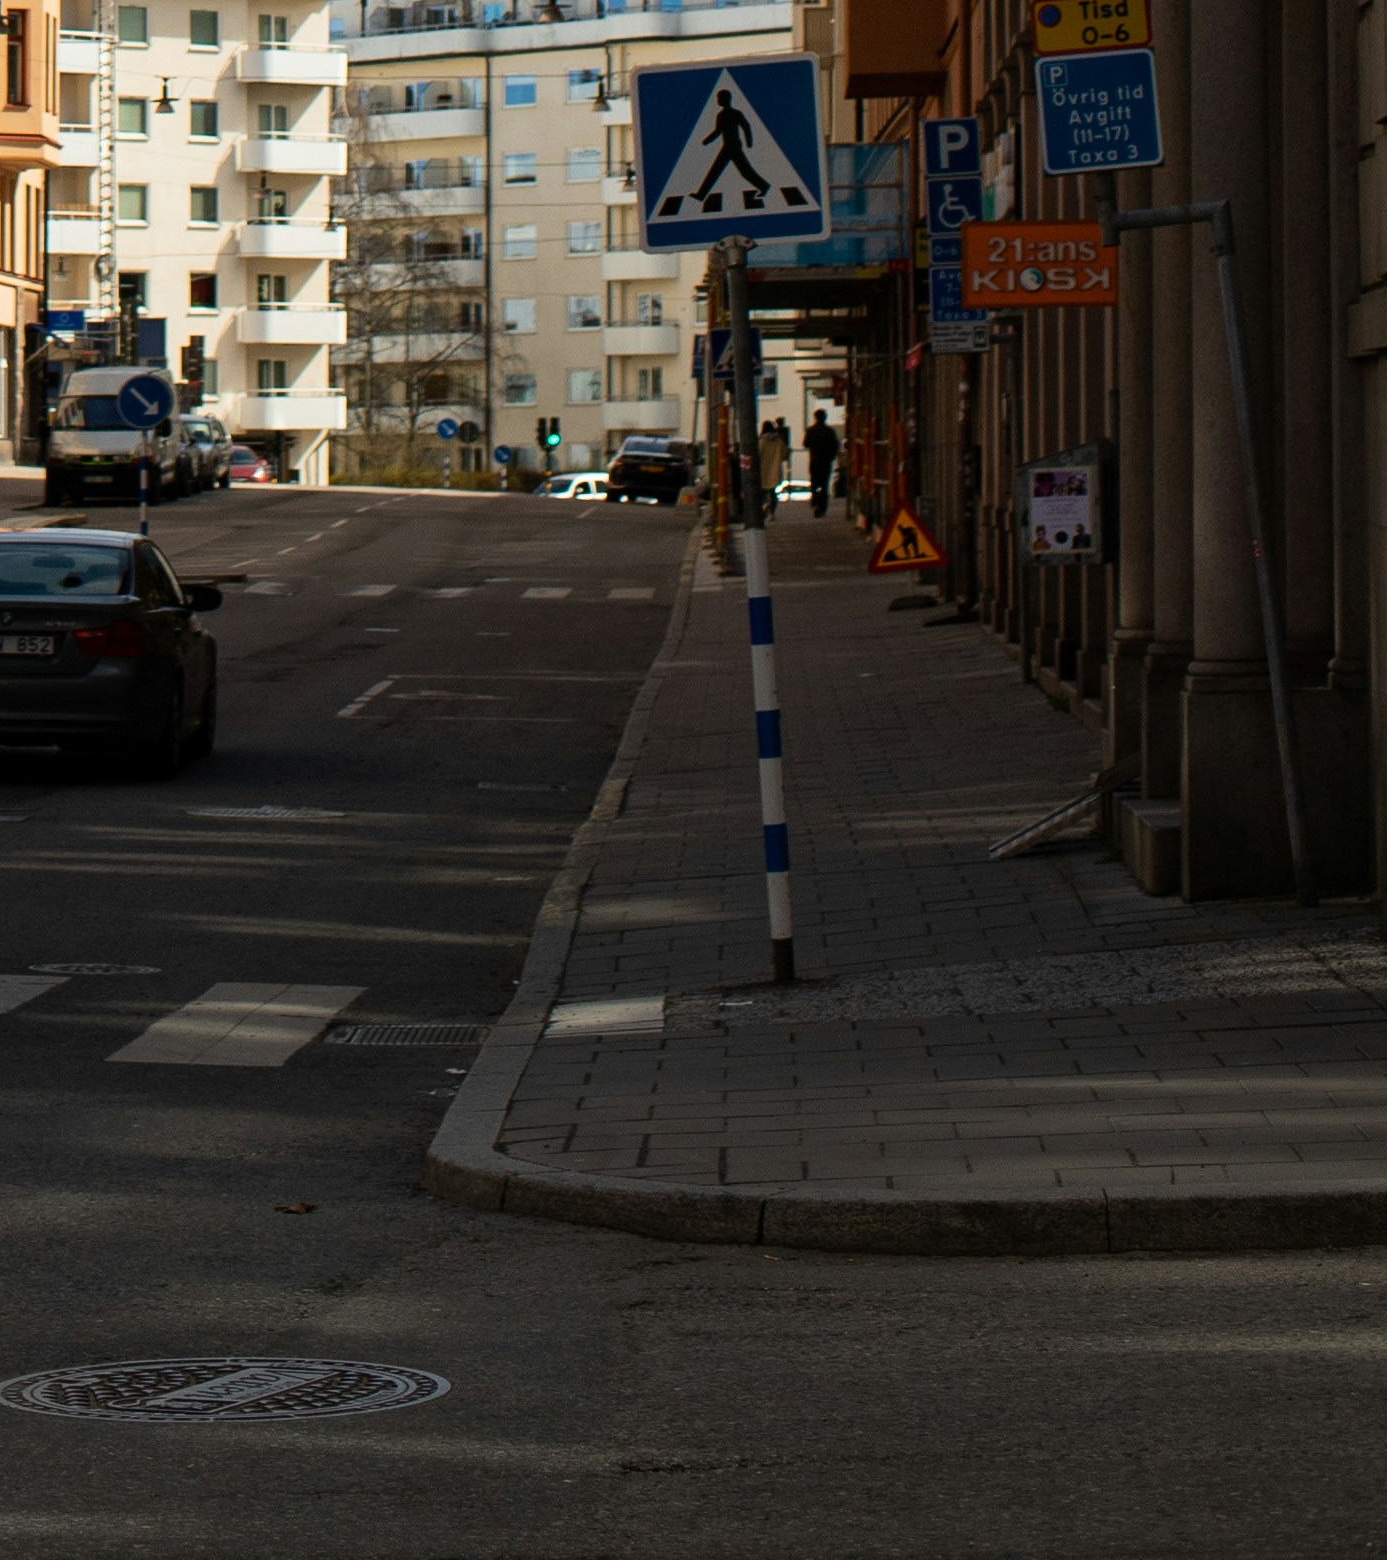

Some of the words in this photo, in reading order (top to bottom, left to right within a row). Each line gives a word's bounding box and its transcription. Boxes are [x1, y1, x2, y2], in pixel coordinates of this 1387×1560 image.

[1082, 23, 1130, 45] 0-6
[1052, 87, 1110, 107] Övrig
[1116, 83, 1144, 101] tid
[1068, 105, 1133, 127] Avgift
[1072, 123, 1131, 146] (11-17)
[937, 123, 971, 170] P
[1068, 148, 1119, 165] Taxa
[1127, 143, 1140, 160] 3
[986, 236, 1097, 264] 21:ans
[971, 266, 1111, 293] KIOSK
